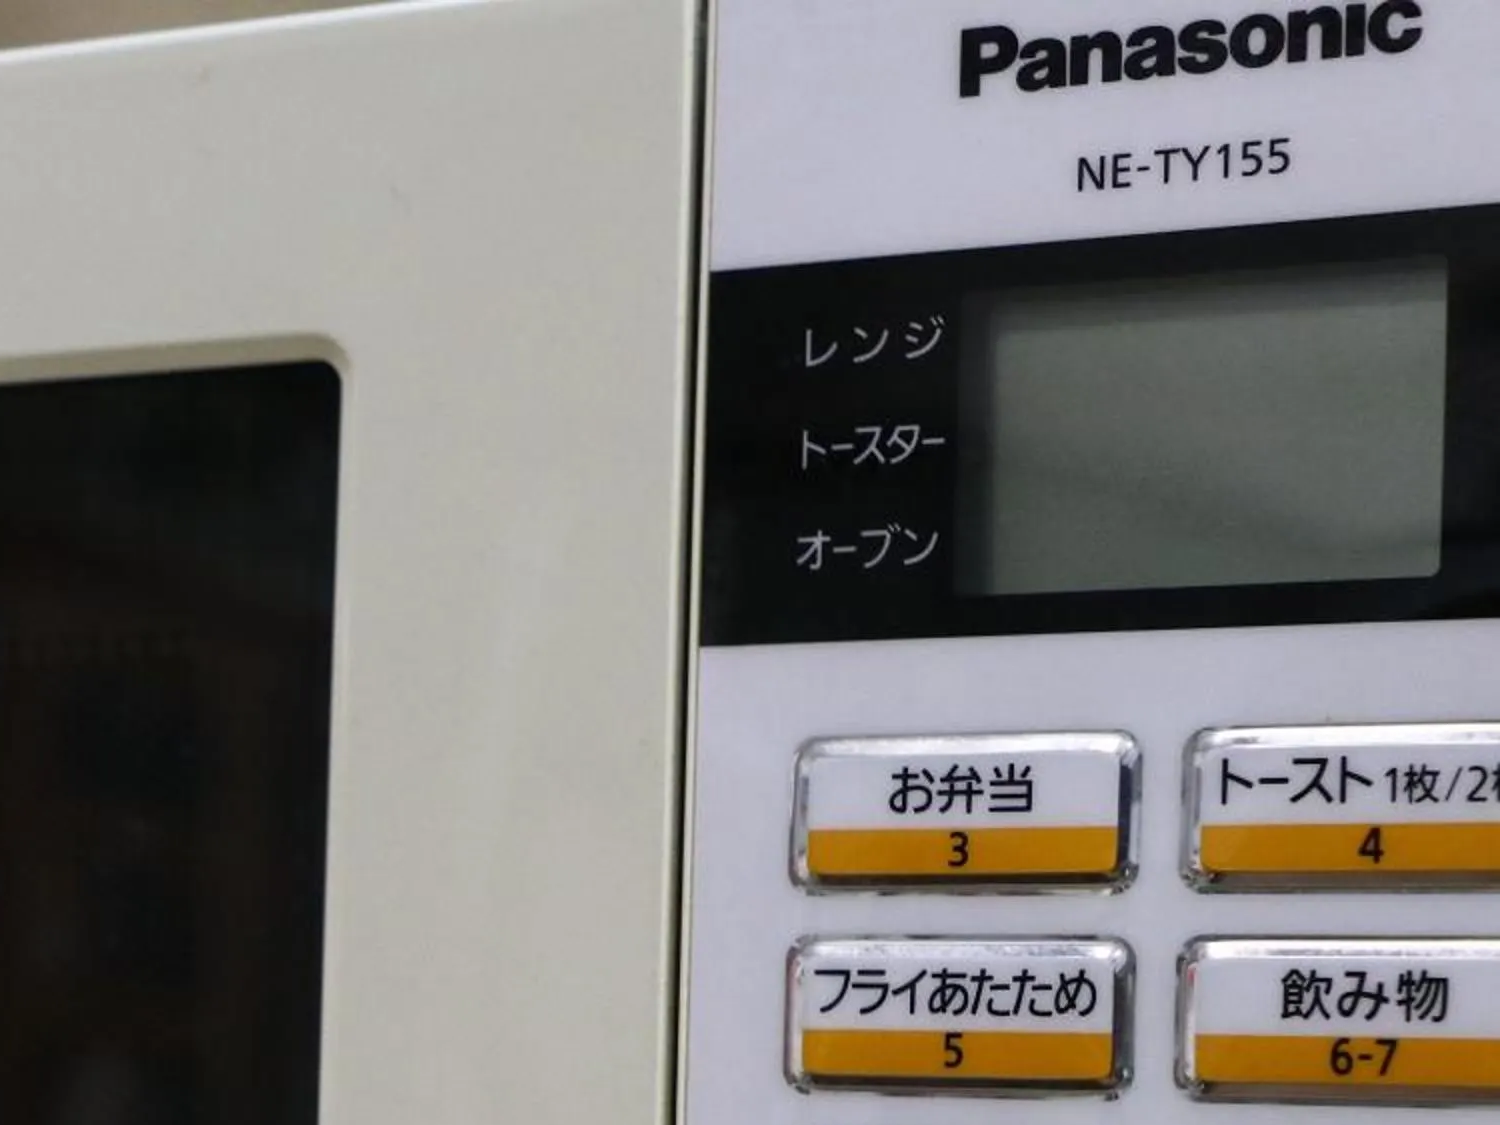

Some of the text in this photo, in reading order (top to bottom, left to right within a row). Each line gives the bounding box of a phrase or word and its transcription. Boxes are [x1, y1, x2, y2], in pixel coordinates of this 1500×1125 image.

[959, 0, 1423, 99] Panasonic
[1077, 137, 1291, 193] NE-TY155
[804, 315, 946, 368] レンジ
[802, 423, 946, 471] トースター
[796, 523, 940, 571] オーブン
[888, 762, 1035, 815] お弁当
[1220, 754, 1500, 806] トースト 1枚/2
[947, 831, 970, 868] 3
[1358, 827, 1385, 865] 4
[813, 966, 1098, 1018] フライあたため
[1280, 968, 1450, 1023] 飲み物
[943, 1031, 965, 1070] 5
[1329, 1037, 1399, 1077] 6-7
